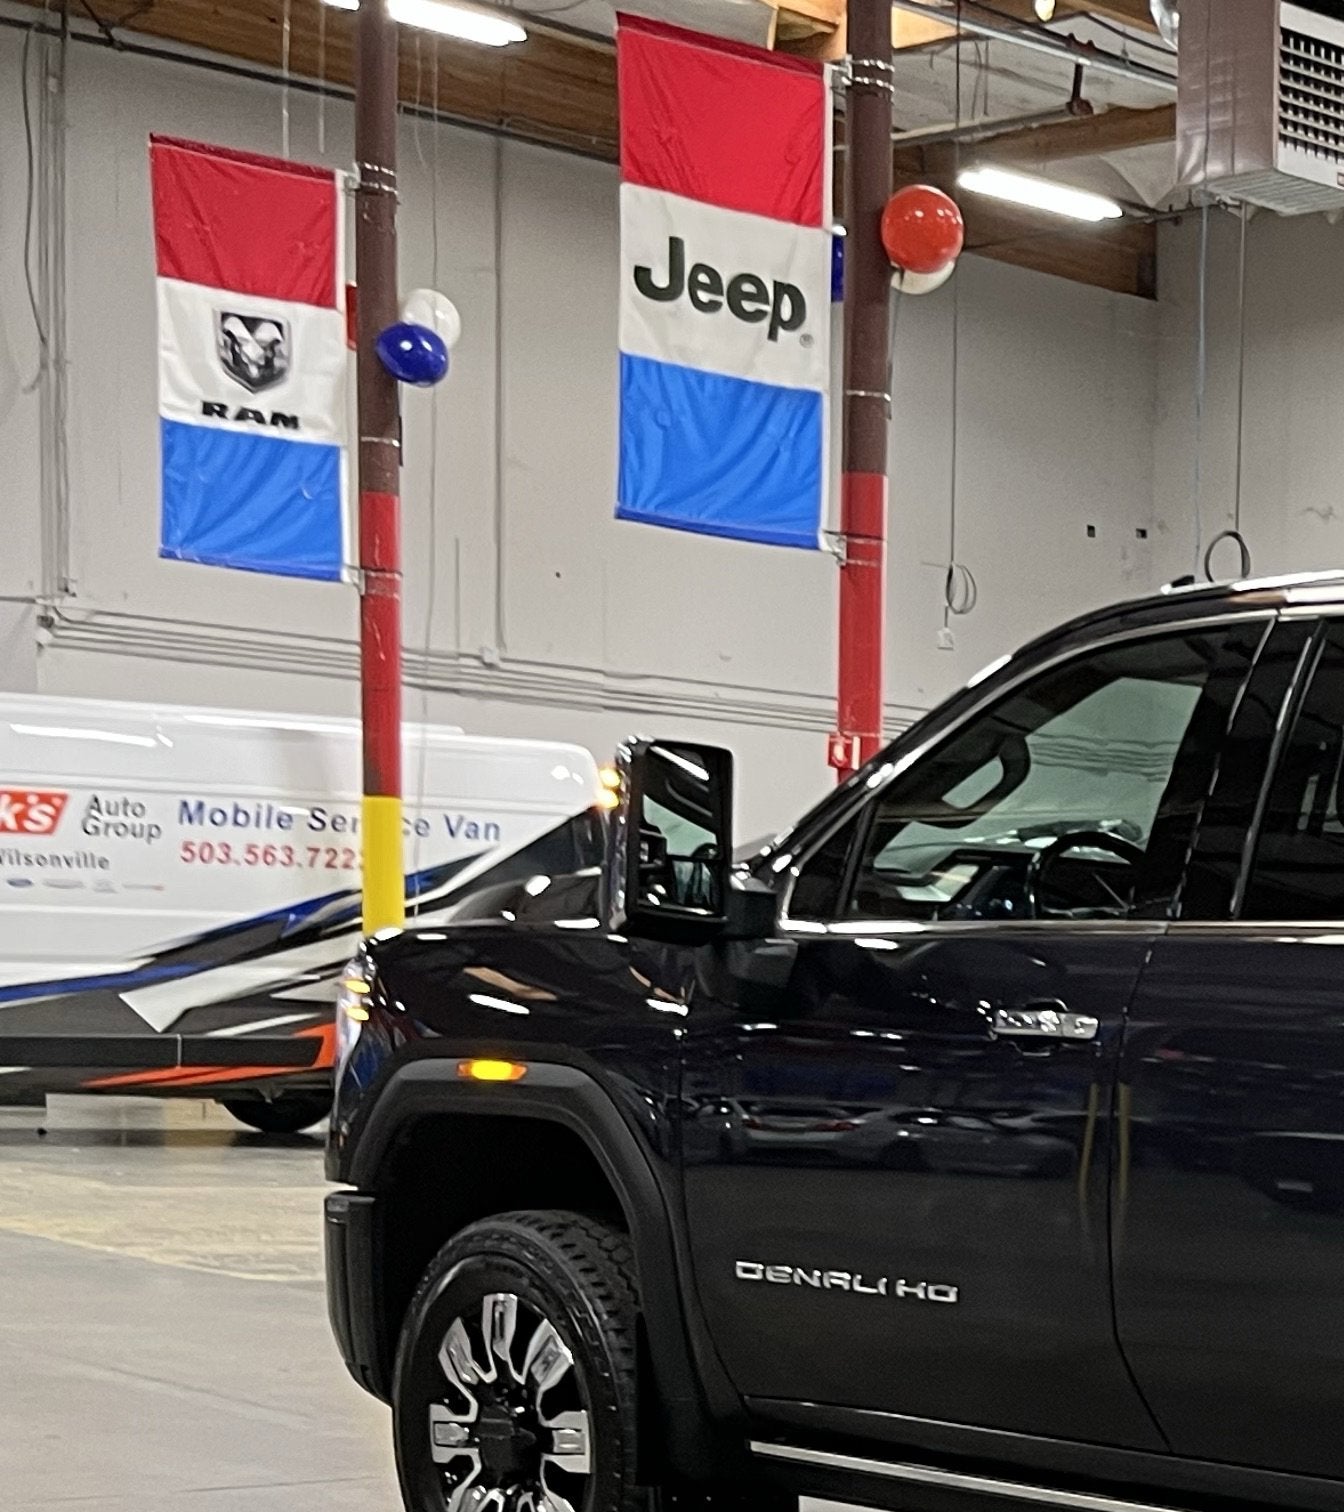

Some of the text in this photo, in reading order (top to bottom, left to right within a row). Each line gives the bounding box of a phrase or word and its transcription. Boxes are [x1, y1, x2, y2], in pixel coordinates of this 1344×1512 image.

[633, 236, 807, 343] Jeep
[202, 401, 299, 430] RAM
[86, 794, 146, 818] Auto
[82, 815, 163, 844] Group
[178, 800, 501, 842] Mobile Serce Van
[180, 840, 364, 869] 503.563.722
[736, 1261, 958, 1302] DENALI HD
